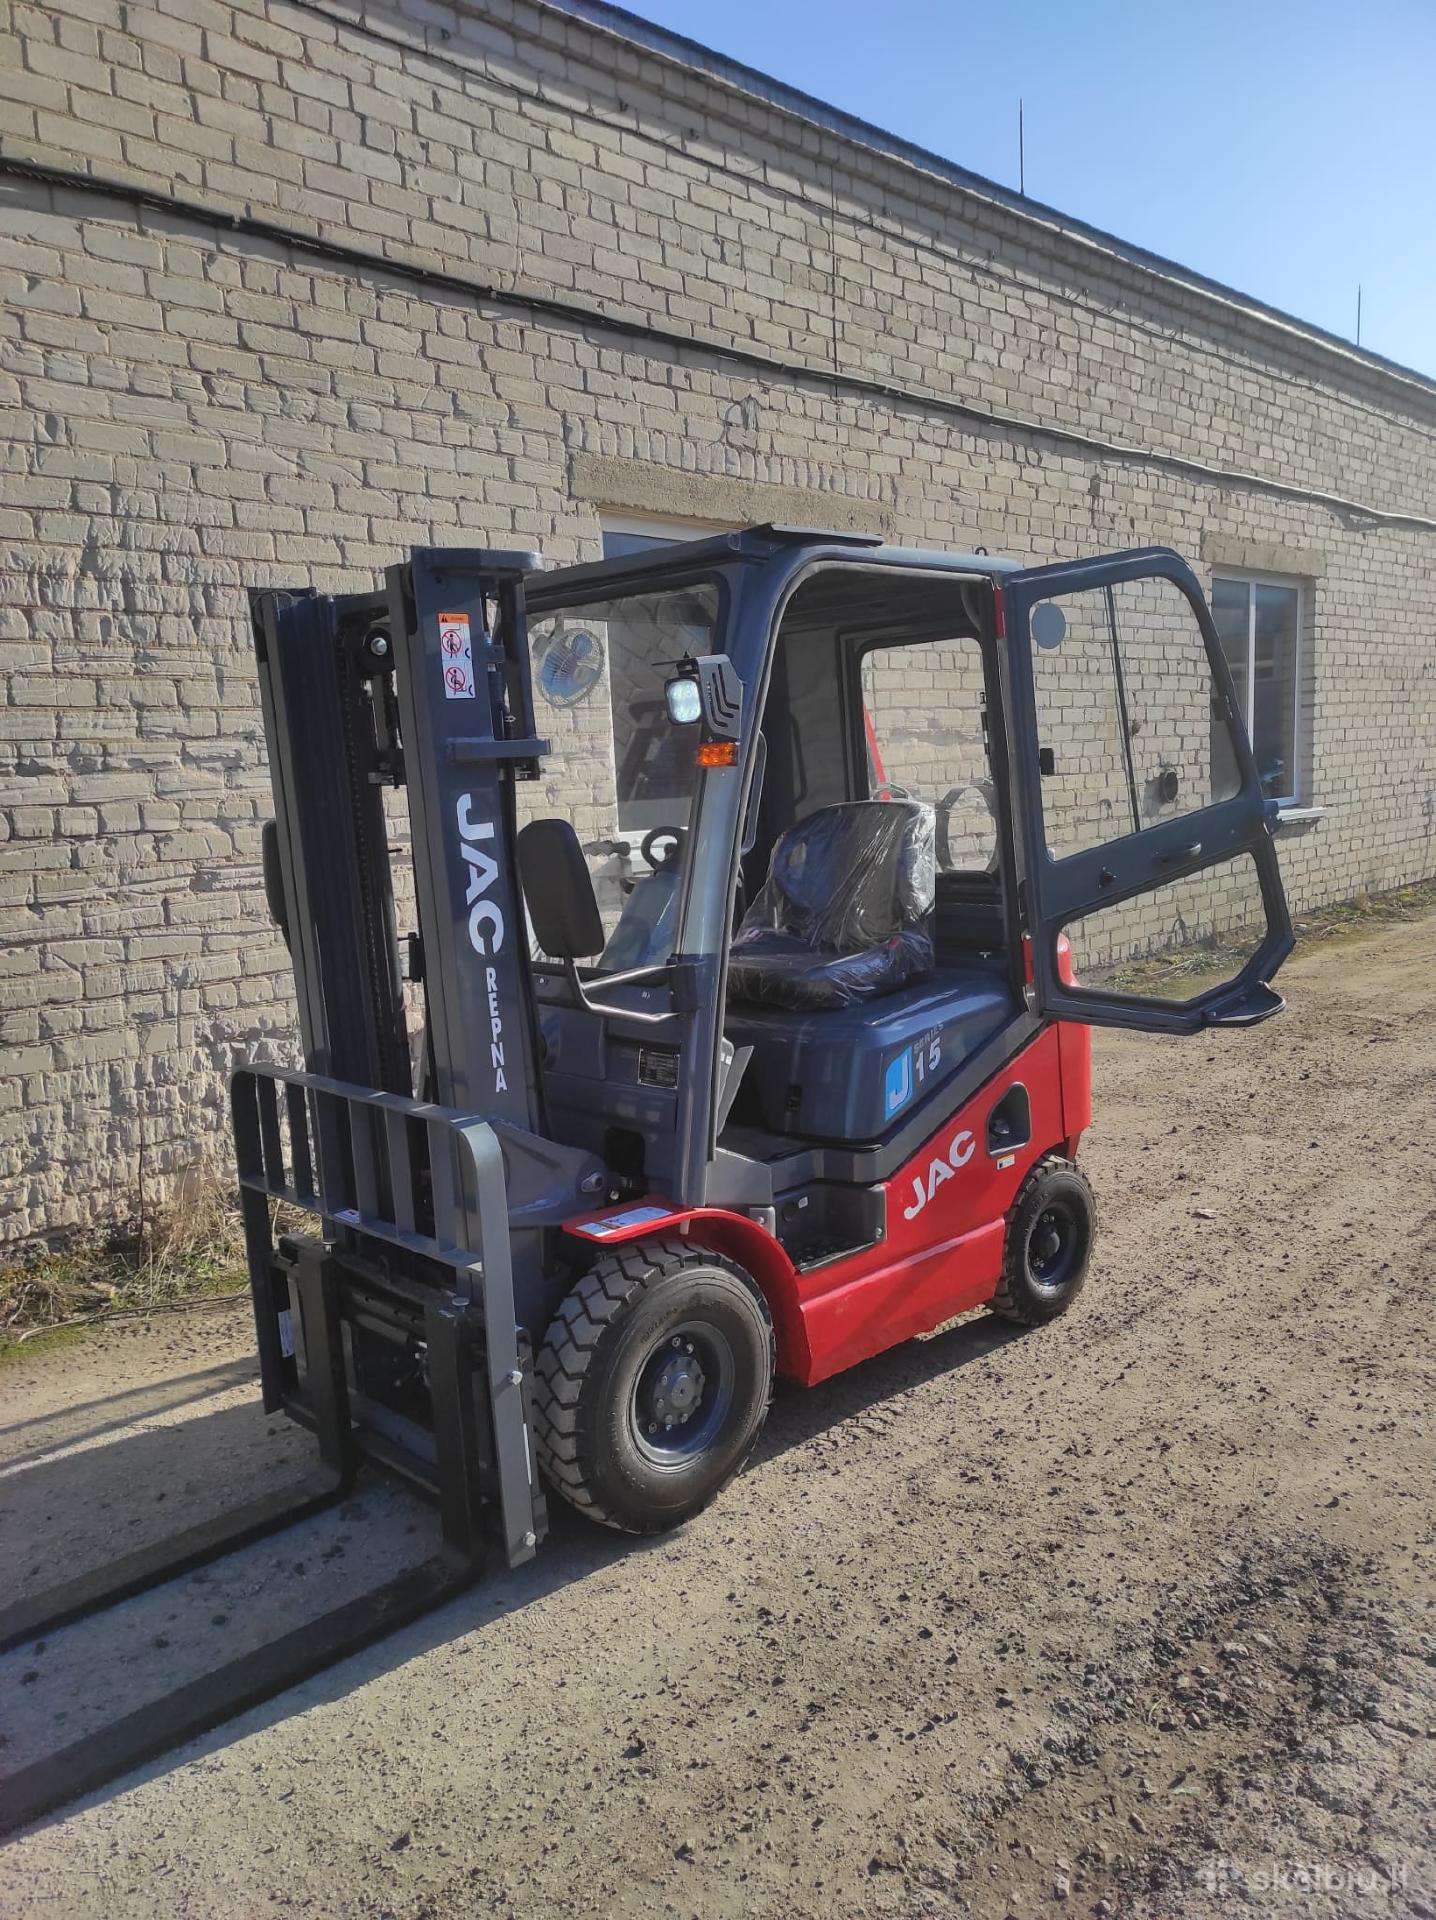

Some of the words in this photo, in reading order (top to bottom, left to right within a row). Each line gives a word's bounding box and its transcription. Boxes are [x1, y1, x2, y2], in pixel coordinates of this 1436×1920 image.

[456, 793, 504, 956] JAC
[485, 967, 508, 1093] REPNA
[915, 1036, 941, 1082] 15
[903, 1130, 976, 1220] JAC
